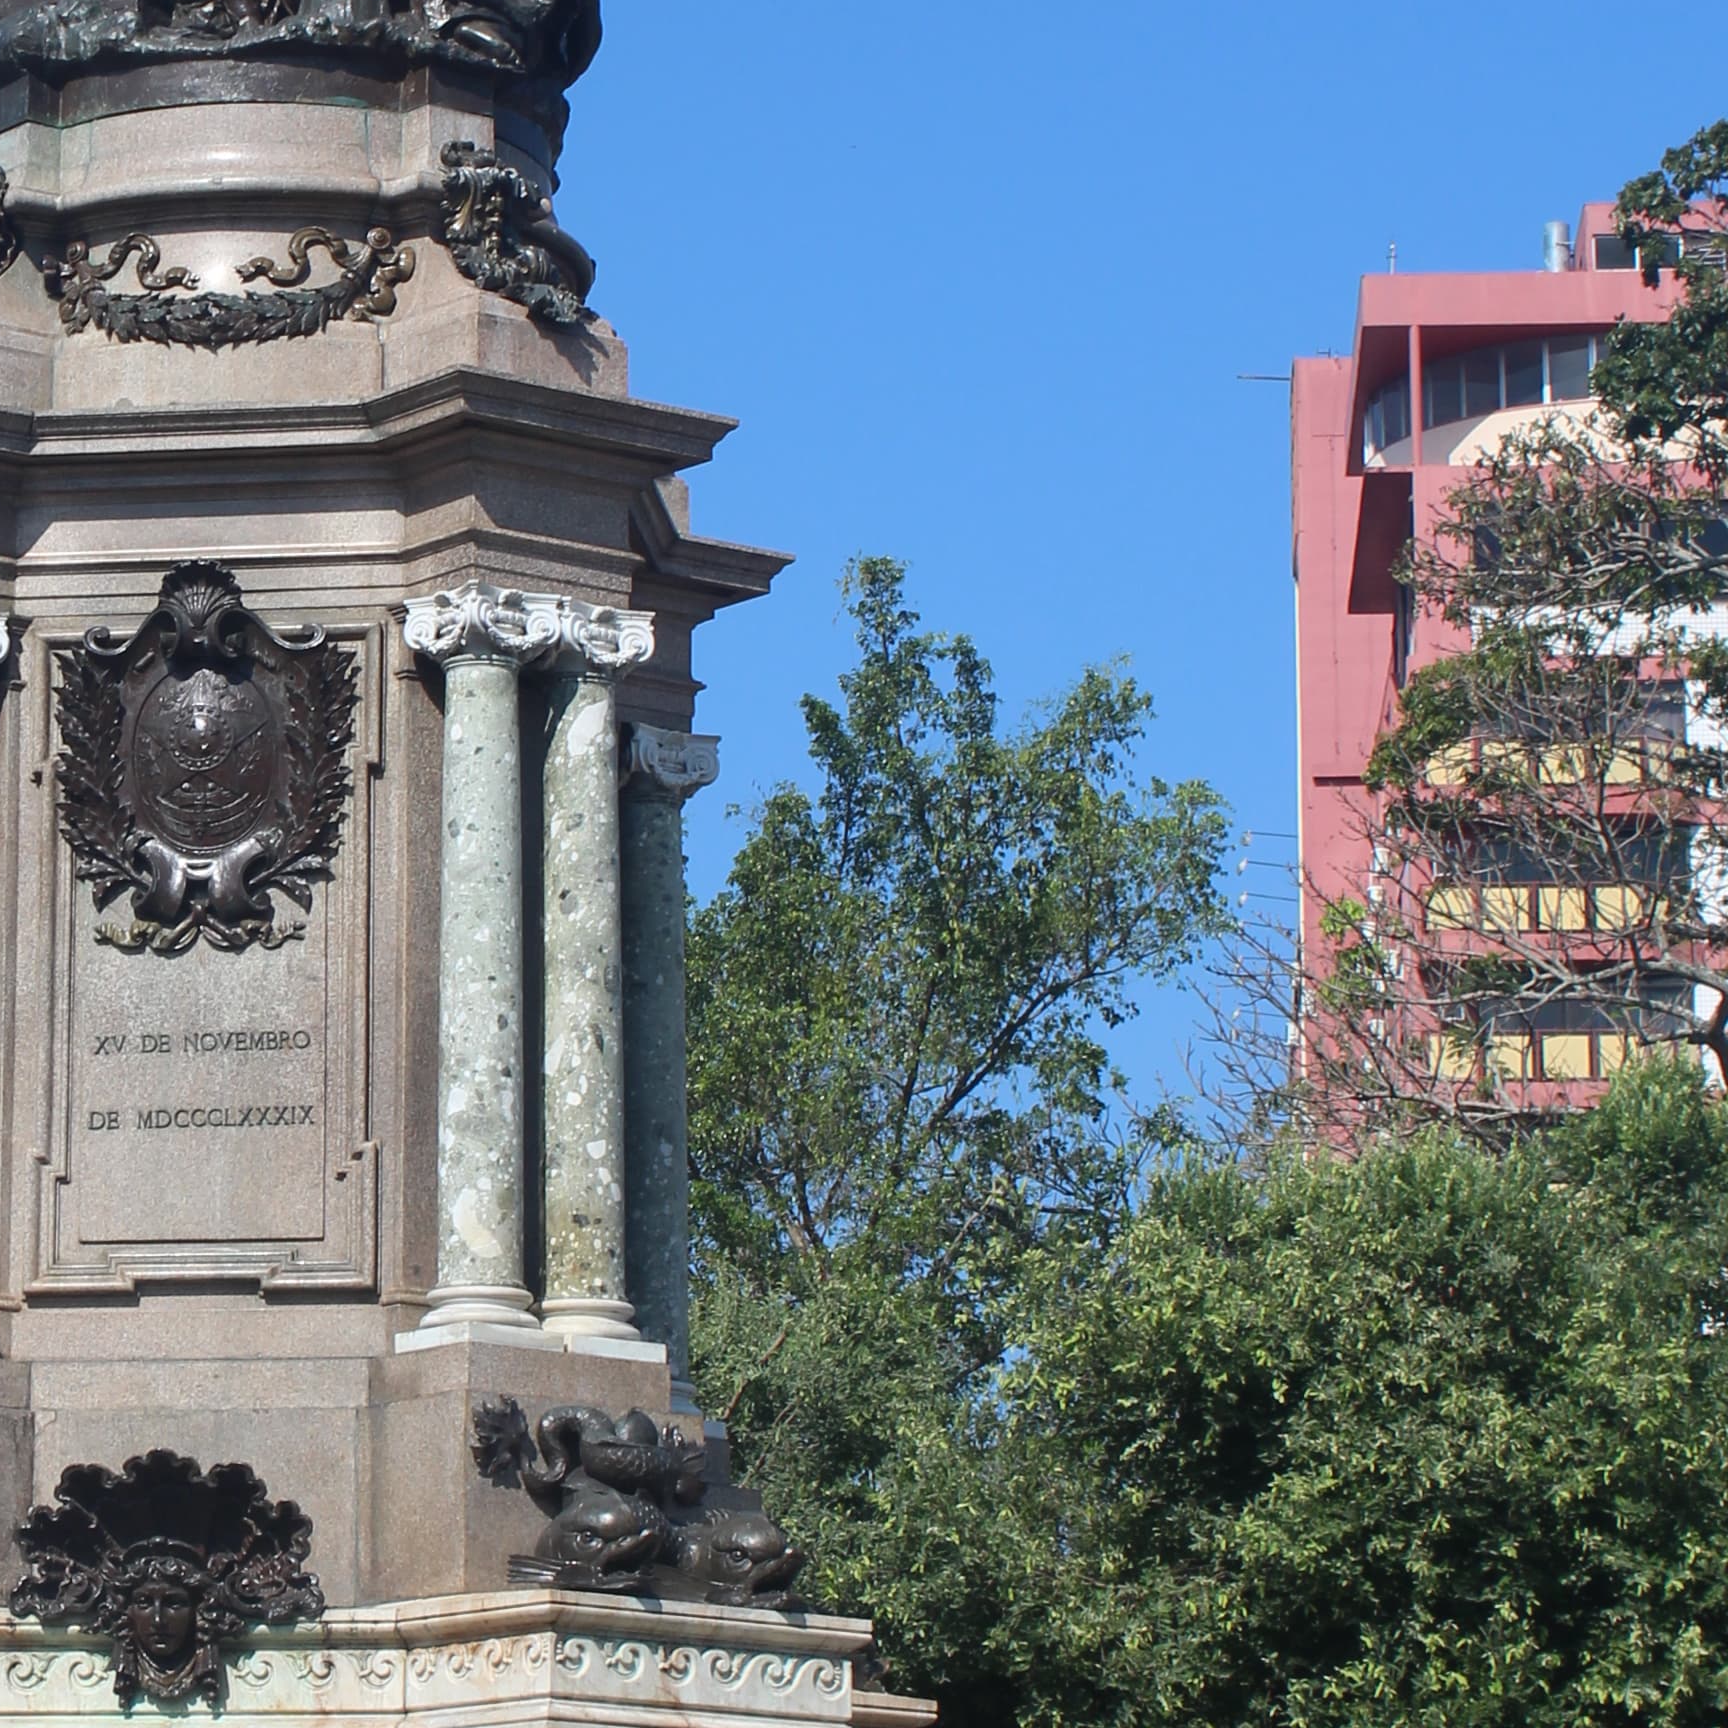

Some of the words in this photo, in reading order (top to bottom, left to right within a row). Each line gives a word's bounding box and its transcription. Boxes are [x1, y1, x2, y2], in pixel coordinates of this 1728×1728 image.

[94, 1035, 126, 1055] XV
[141, 1034, 170, 1053] DE
[183, 1031, 311, 1053] NOVEMBRO
[88, 1111, 120, 1130] DE
[137, 1105, 314, 1129] MDCCCLXXXIX
